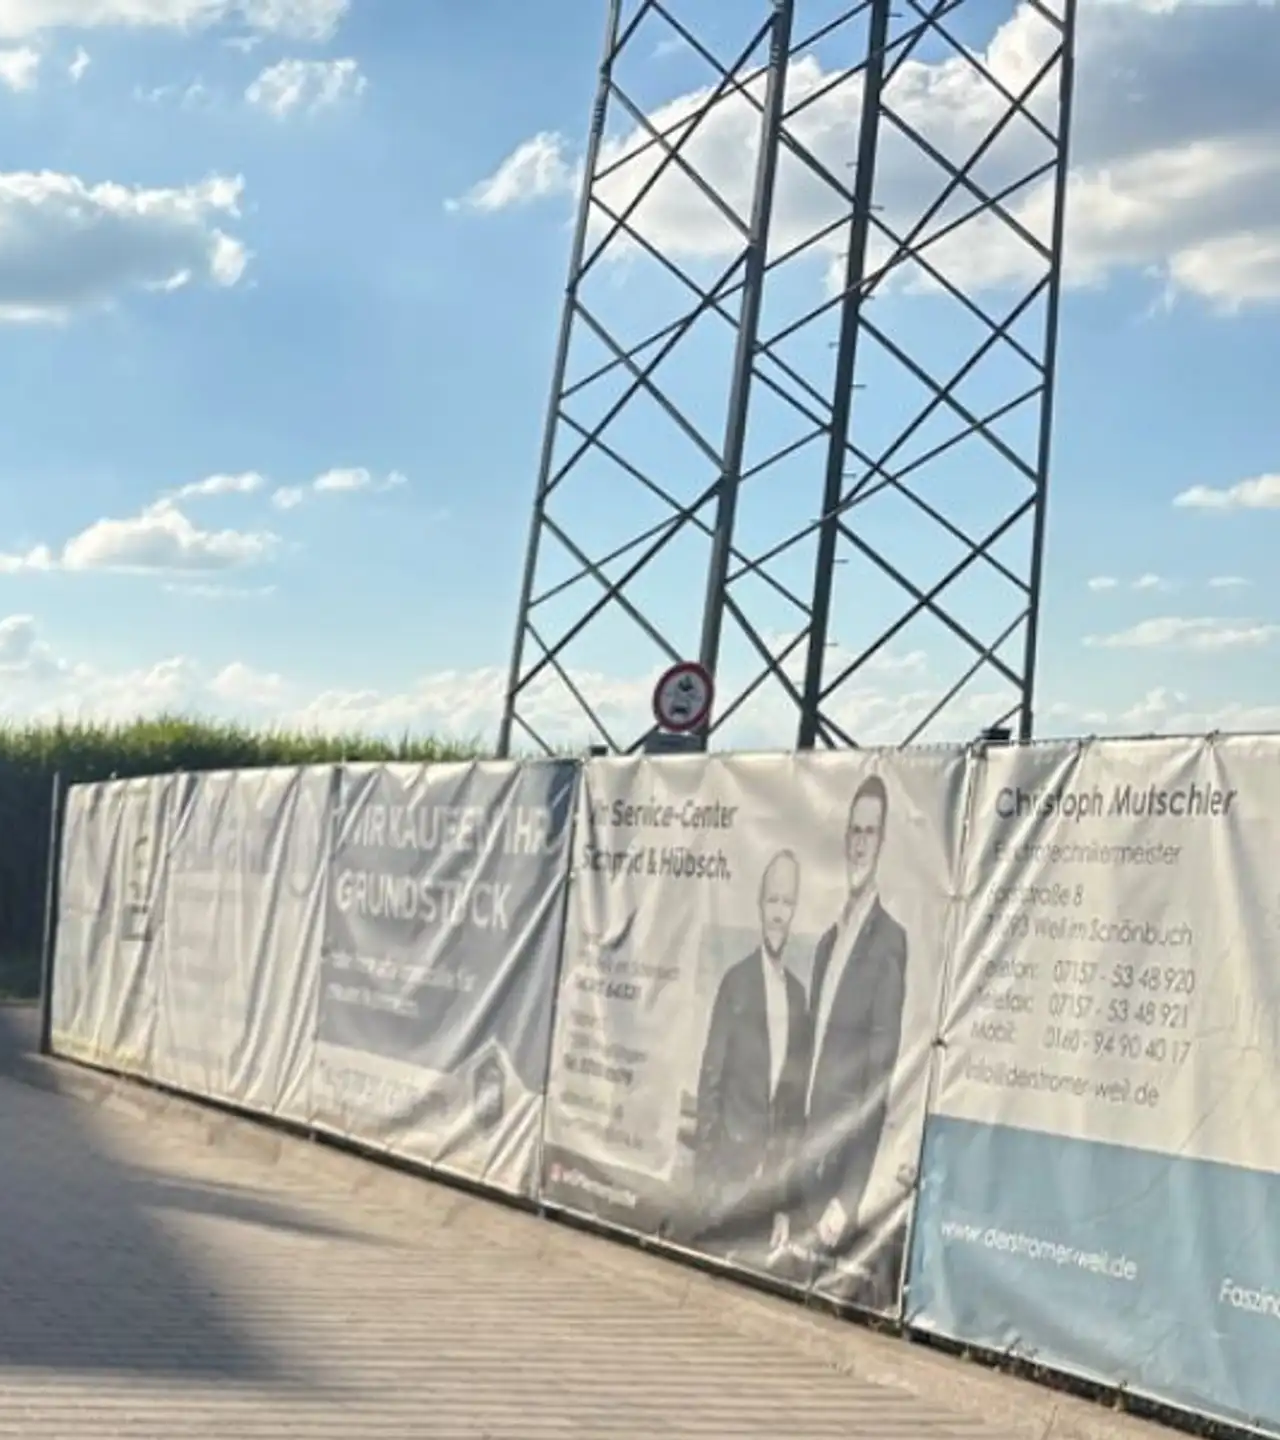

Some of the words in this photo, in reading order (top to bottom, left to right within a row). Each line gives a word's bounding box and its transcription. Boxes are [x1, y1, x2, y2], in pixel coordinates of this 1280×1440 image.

[611, 797, 738, 829] Service-Center
[996, 785, 1104, 823] Chrstoph
[1109, 781, 1237, 817] Mutschler
[1089, 917, 1194, 947] Schönbuch
[1111, 963, 1134, 990] 53
[1138, 967, 1162, 992] 48
[1164, 967, 1196, 994] 920
[1107, 998, 1129, 1023] 53
[1133, 1002, 1156, 1027] 48
[1159, 1003, 1188, 1029] 921
[1093, 1030, 1116, 1057] 94
[1119, 1033, 1141, 1059] 90
